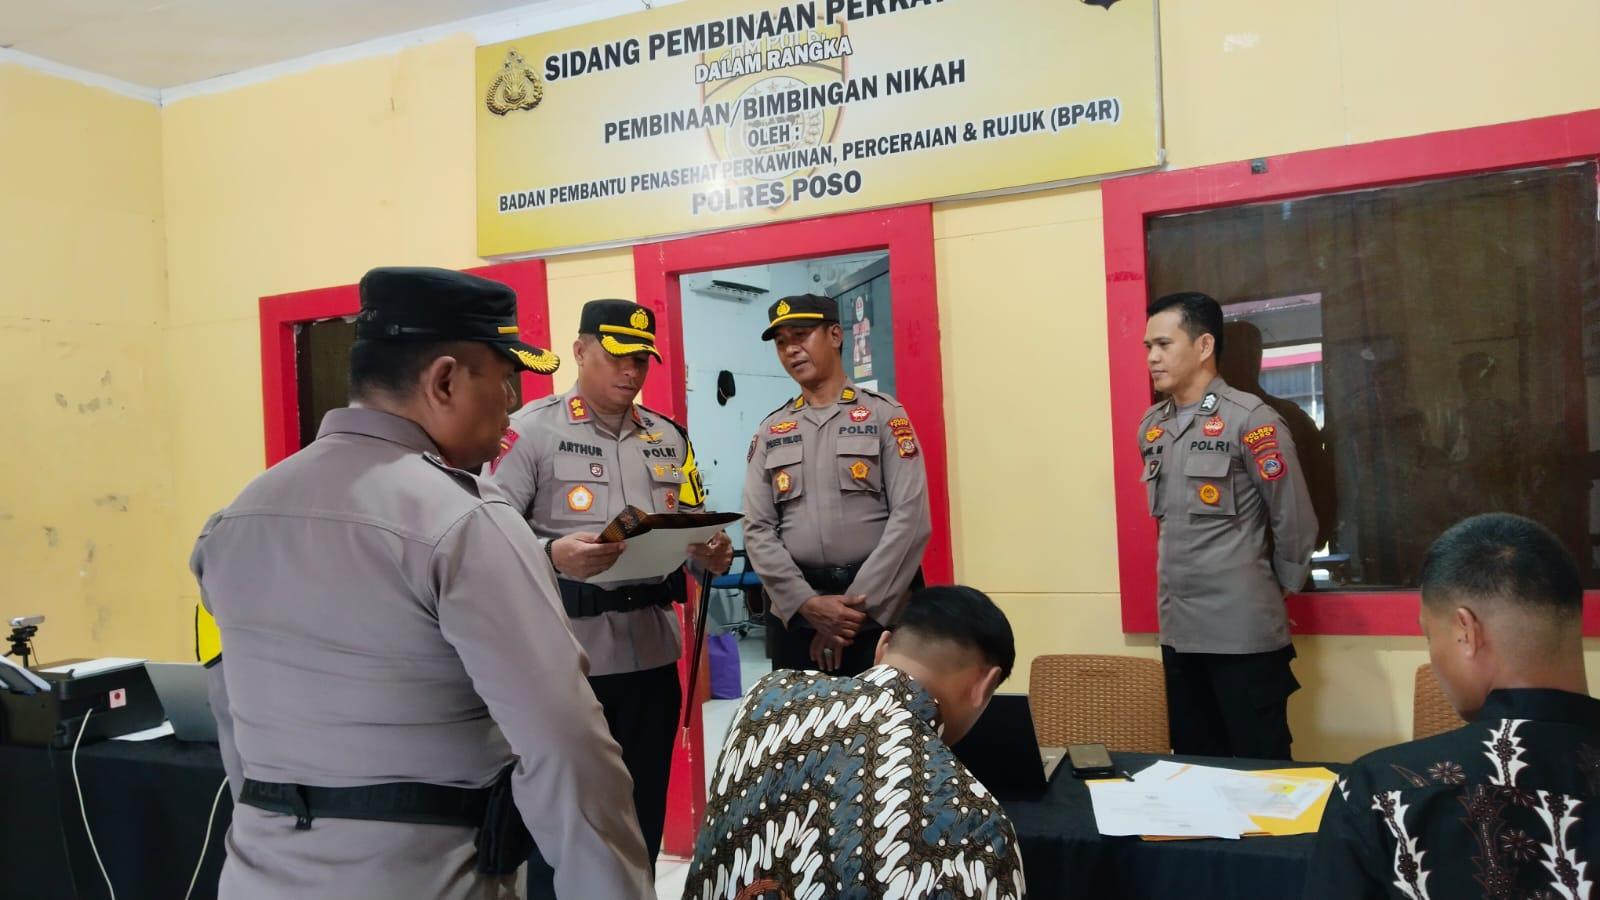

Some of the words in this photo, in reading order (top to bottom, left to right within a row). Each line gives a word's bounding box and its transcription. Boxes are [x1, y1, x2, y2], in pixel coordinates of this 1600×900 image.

[545, 38, 640, 82] SIDANG
[649, 2, 816, 61] PEMBINAAN
[694, 53, 762, 84] DALAM
[766, 35, 853, 70] RANGKA
[886, 59, 966, 95] NIKAH
[499, 189, 546, 211] BADAN
[550, 176, 626, 204] PEMBANTU
[630, 163, 718, 193] PENASEHAT
[724, 145, 838, 182] PERKAWINAN,
[843, 125, 957, 161] PERCERAIAN
[963, 123, 977, 141] &
[983, 111, 1046, 139] RUJUK
[1051, 99, 1120, 131] (BP4R)
[694, 182, 785, 214] POLRES
[793, 170, 862, 200] POSO
[839, 425, 878, 435] POLRI
[1190, 440, 1229, 453] POLRI
[558, 440, 602, 457] ARTHUR
[643, 447, 677, 459] POLRI
